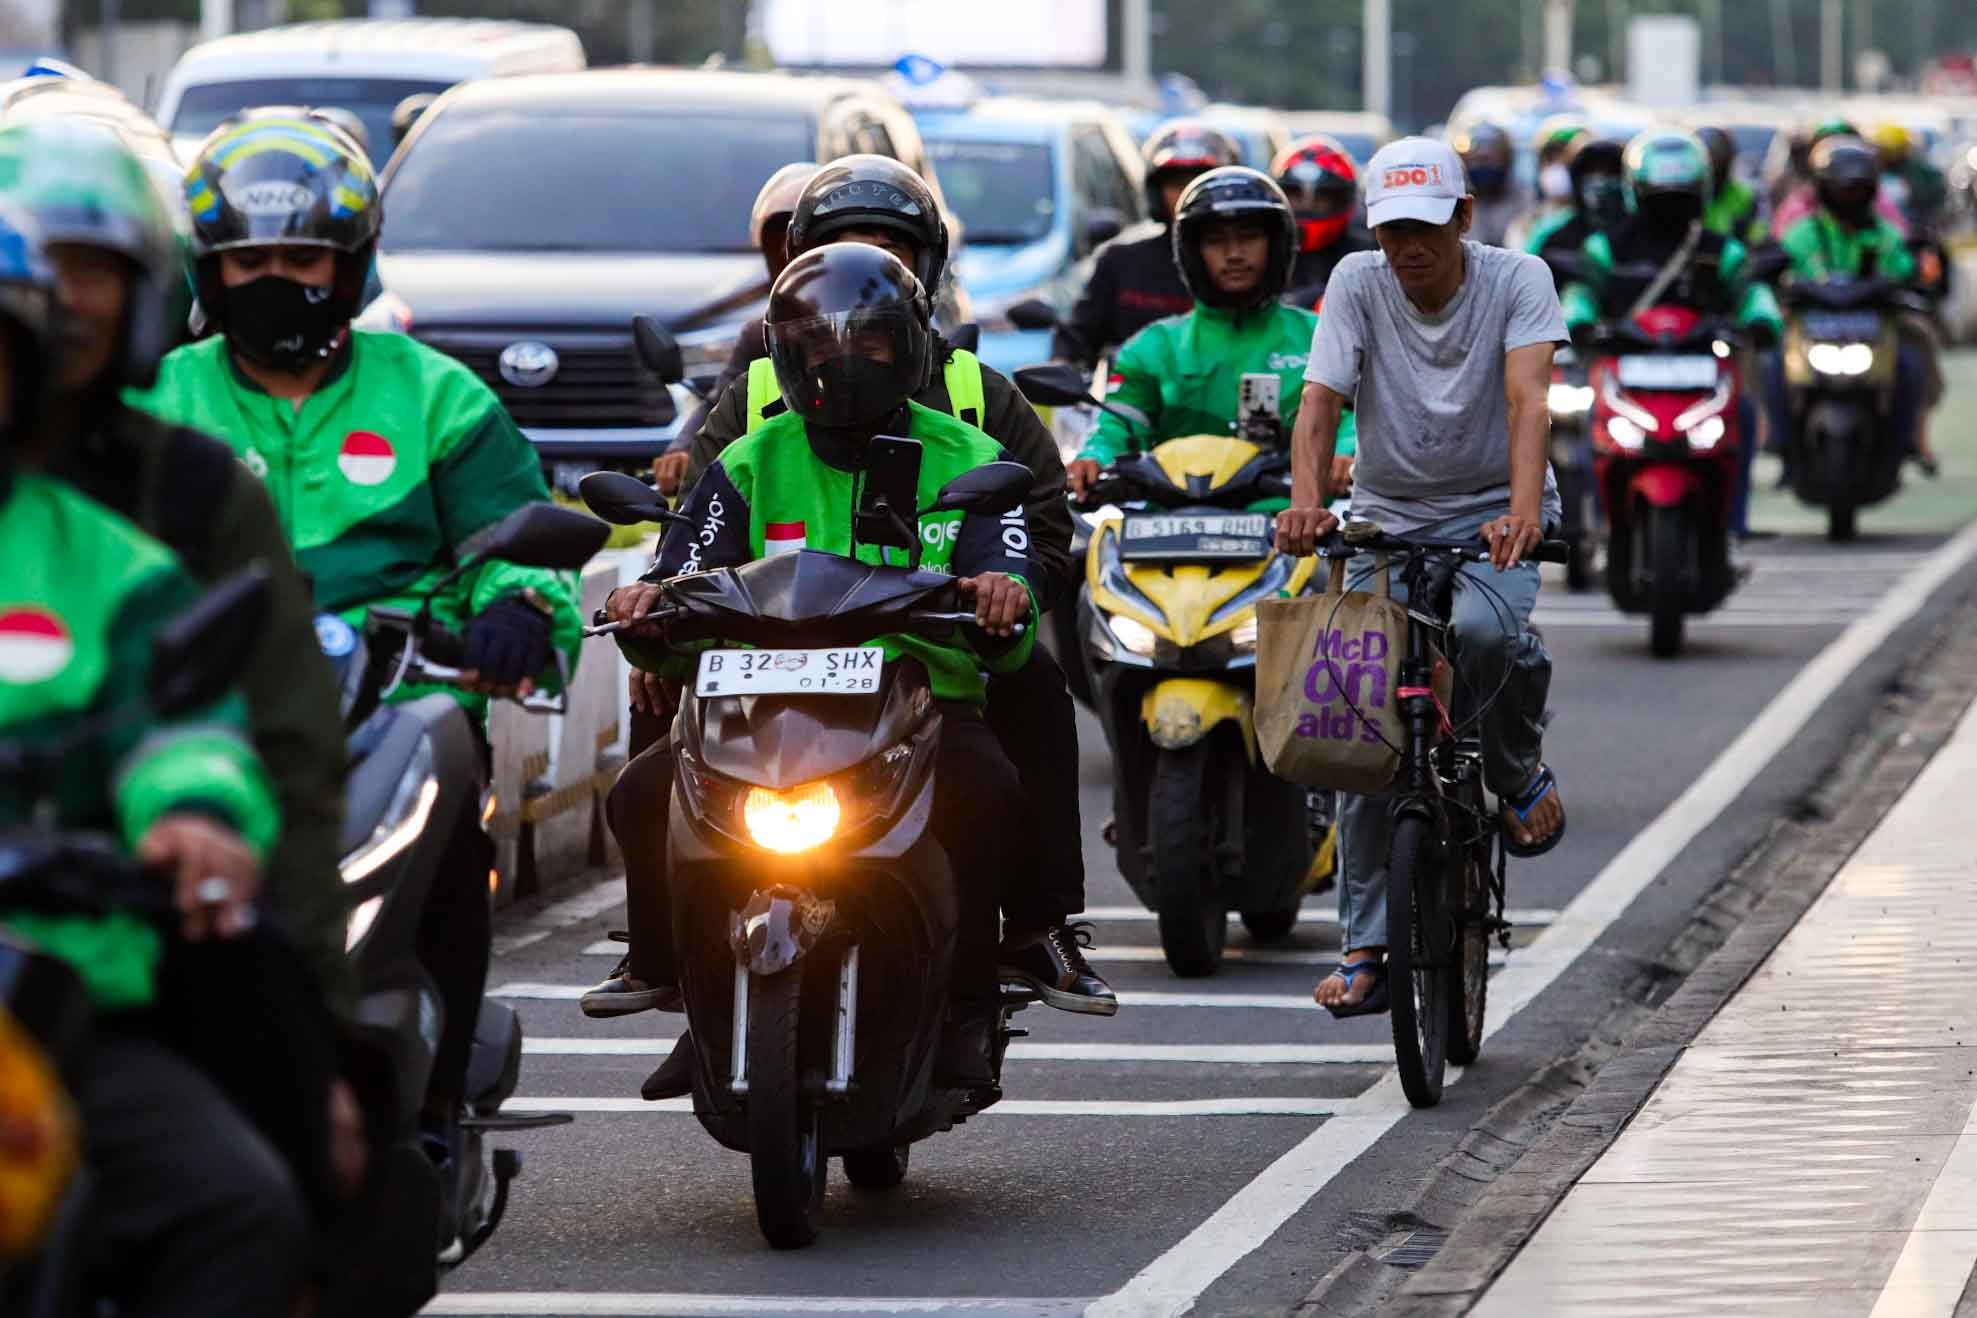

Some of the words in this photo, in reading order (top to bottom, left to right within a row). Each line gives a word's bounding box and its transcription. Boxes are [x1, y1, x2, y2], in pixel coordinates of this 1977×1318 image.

[917, 520, 962, 553] oje
[1312, 627, 1389, 661] McD
[708, 654, 725, 673] B
[825, 650, 878, 671] SHX
[1303, 659, 1387, 709] on
